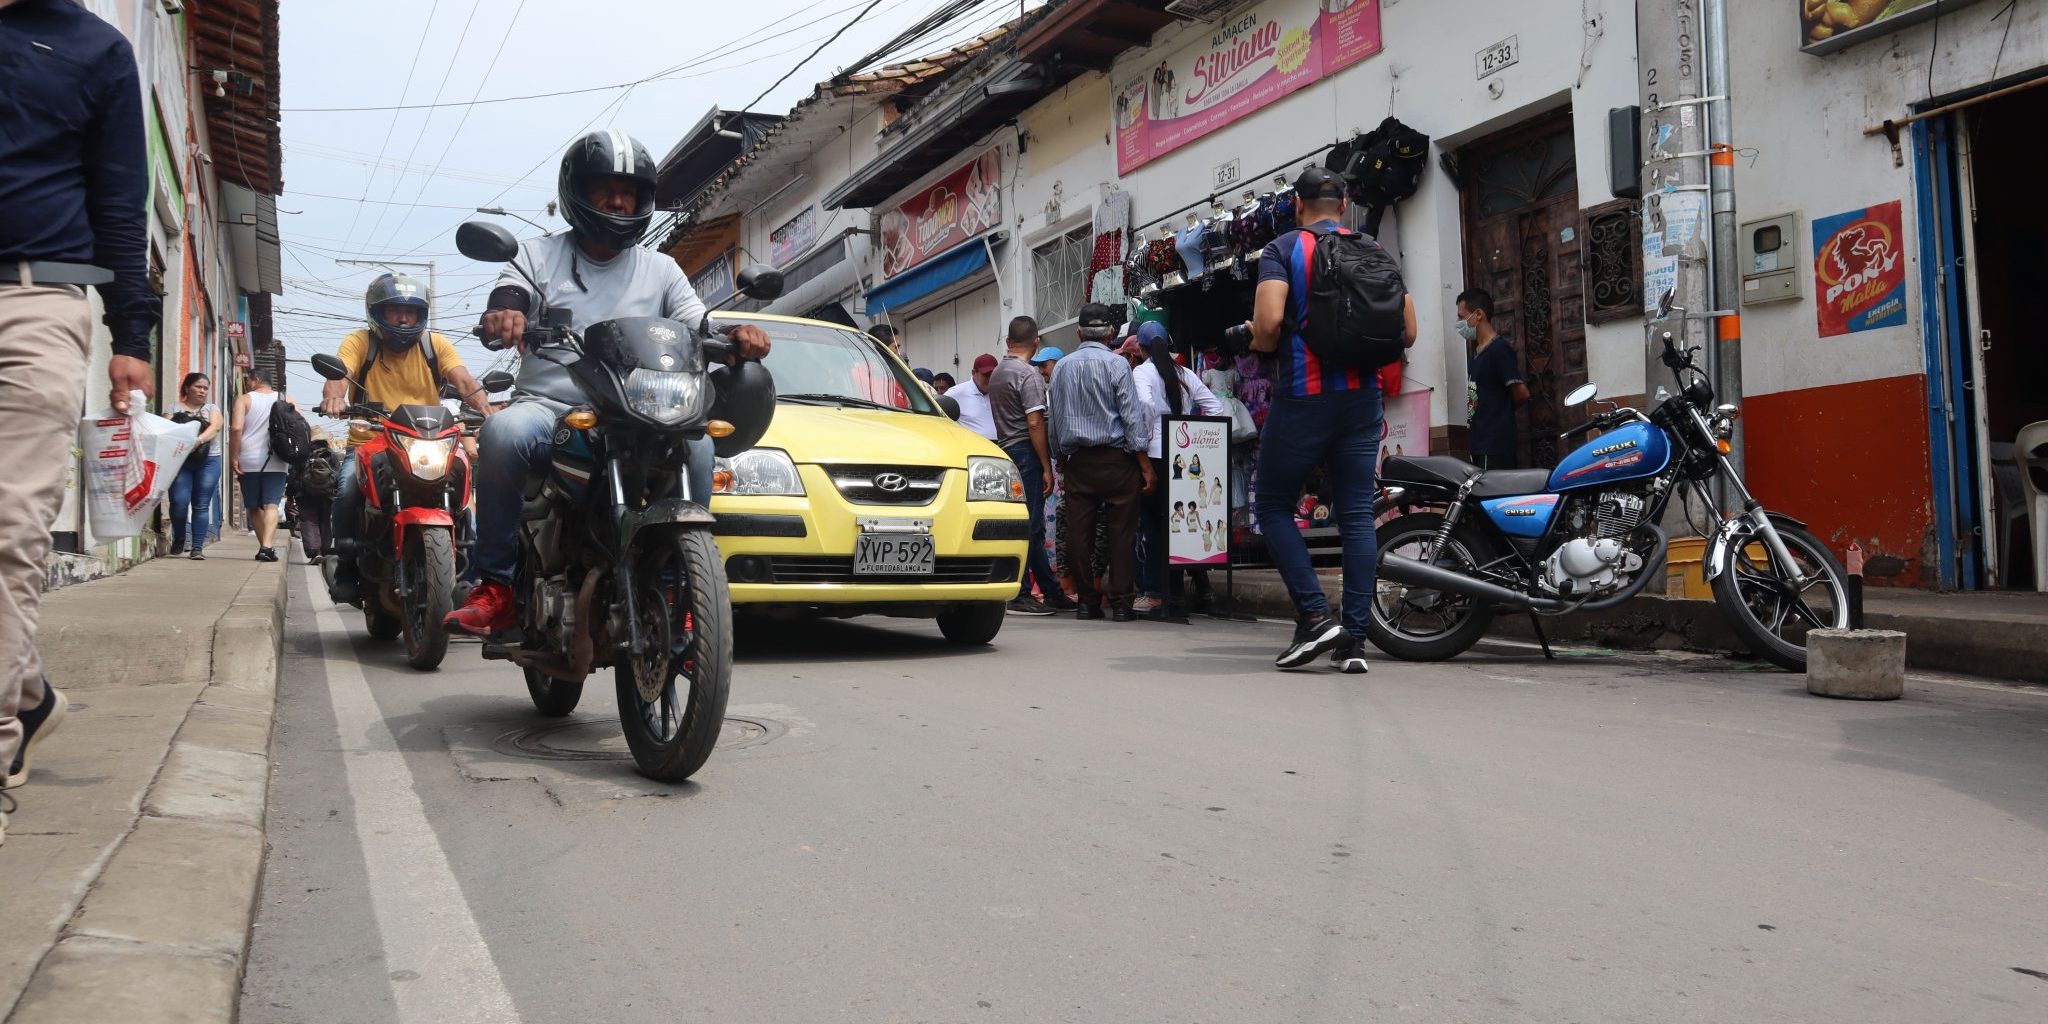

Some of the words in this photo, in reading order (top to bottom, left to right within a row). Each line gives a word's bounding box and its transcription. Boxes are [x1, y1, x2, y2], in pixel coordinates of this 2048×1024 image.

[1211, 13, 1257, 49] ALMACÉN
[1185, 20, 1281, 104] Silviana
[1482, 45, 1511, 70] 12-33
[1218, 165, 1235, 183] 12-31
[1841, 279, 1888, 314] Malta
[1592, 440, 1637, 456] SUZUKI
[866, 564, 921, 572] FLORIDABLANCA
